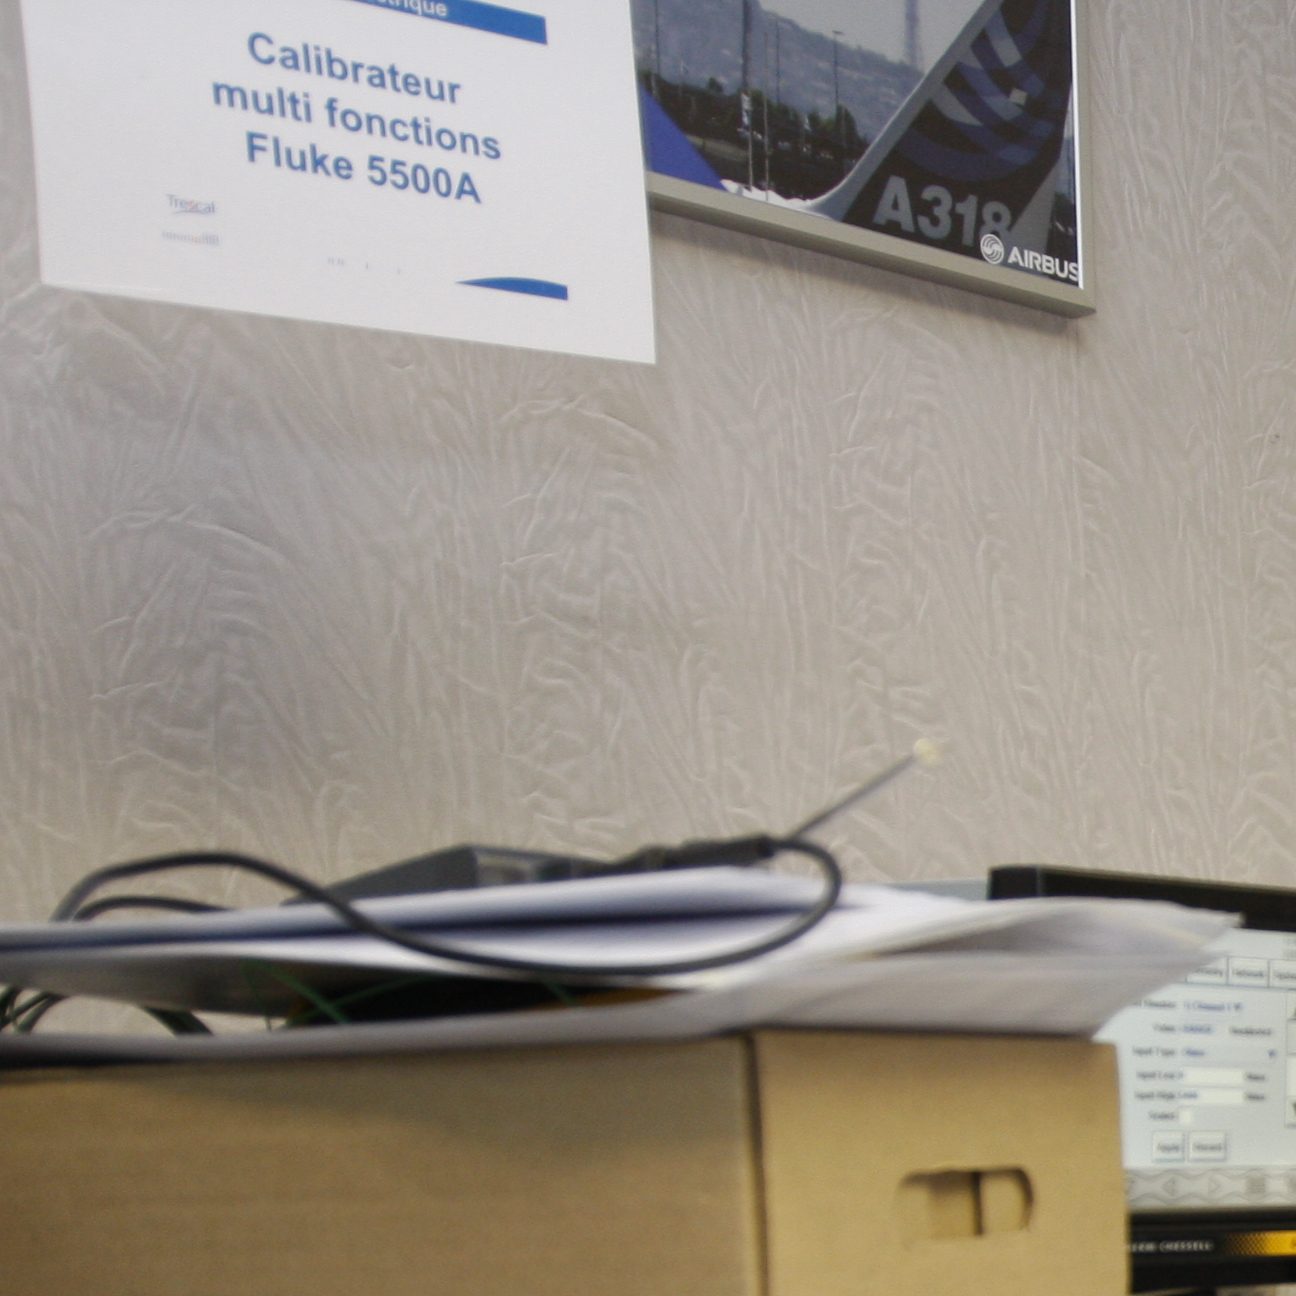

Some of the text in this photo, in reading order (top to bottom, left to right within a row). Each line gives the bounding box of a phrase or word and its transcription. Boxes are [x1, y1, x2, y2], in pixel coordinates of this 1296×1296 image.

[247, 32, 461, 104] Calibrateur
[212, 81, 501, 160] multi fonctions
[246, 131, 483, 204] Fluke 5500A
[873, 175, 1015, 248] A318
[1006, 246, 1079, 283] AIRBUS
